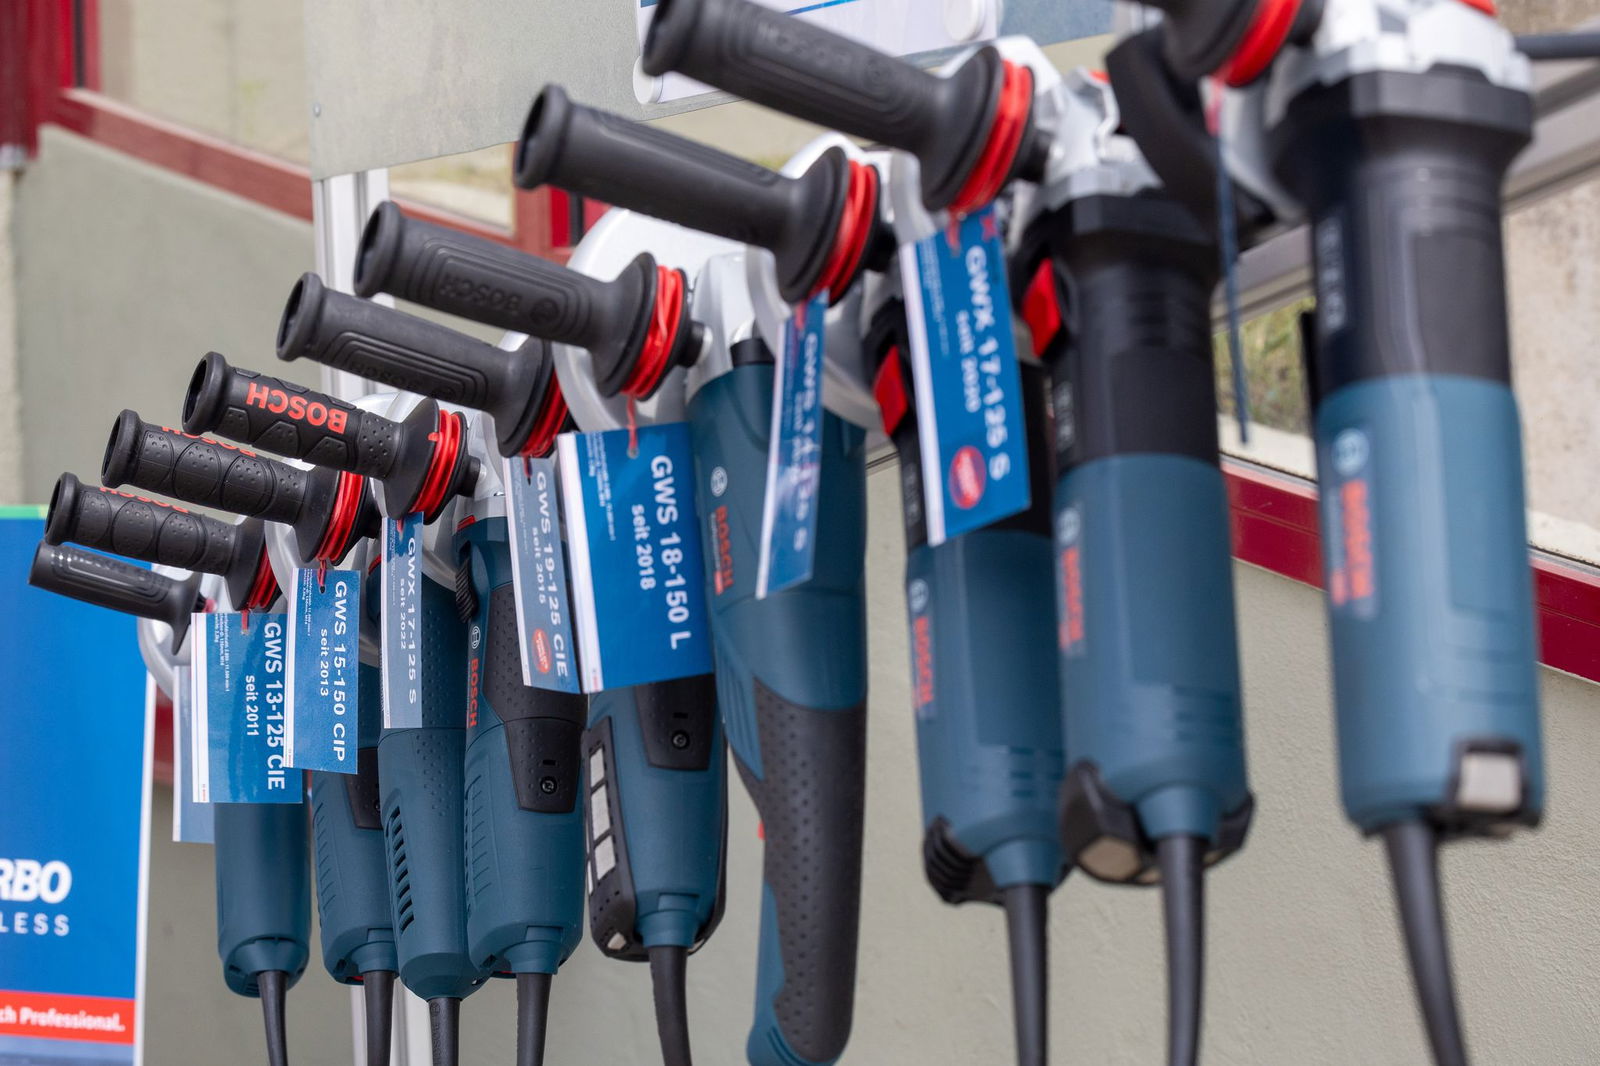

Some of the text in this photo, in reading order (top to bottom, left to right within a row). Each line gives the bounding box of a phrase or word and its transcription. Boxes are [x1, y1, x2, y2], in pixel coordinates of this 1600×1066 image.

[965, 245, 1012, 481] GWX 17-125 S
[246, 382, 348, 435] BOSCH
[532, 527, 542, 560] seit
[536, 471, 569, 678] GWS 19-125 CIE
[632, 504, 656, 590] seit 2018
[651, 455, 692, 650] GWS 18-150 L
[407, 537, 417, 705] GWX 17-125 S
[320, 628, 328, 697] seit 2013
[332, 580, 348, 762] GWS 15-150 CIP
[469, 658, 479, 727] BOSCH
[245, 675, 260, 736] seit 2011
[263, 622, 285, 790] GWS 13-125 CIE
[0, 910, 70, 937] LESS
[19, 1005, 126, 1033] Professional.
